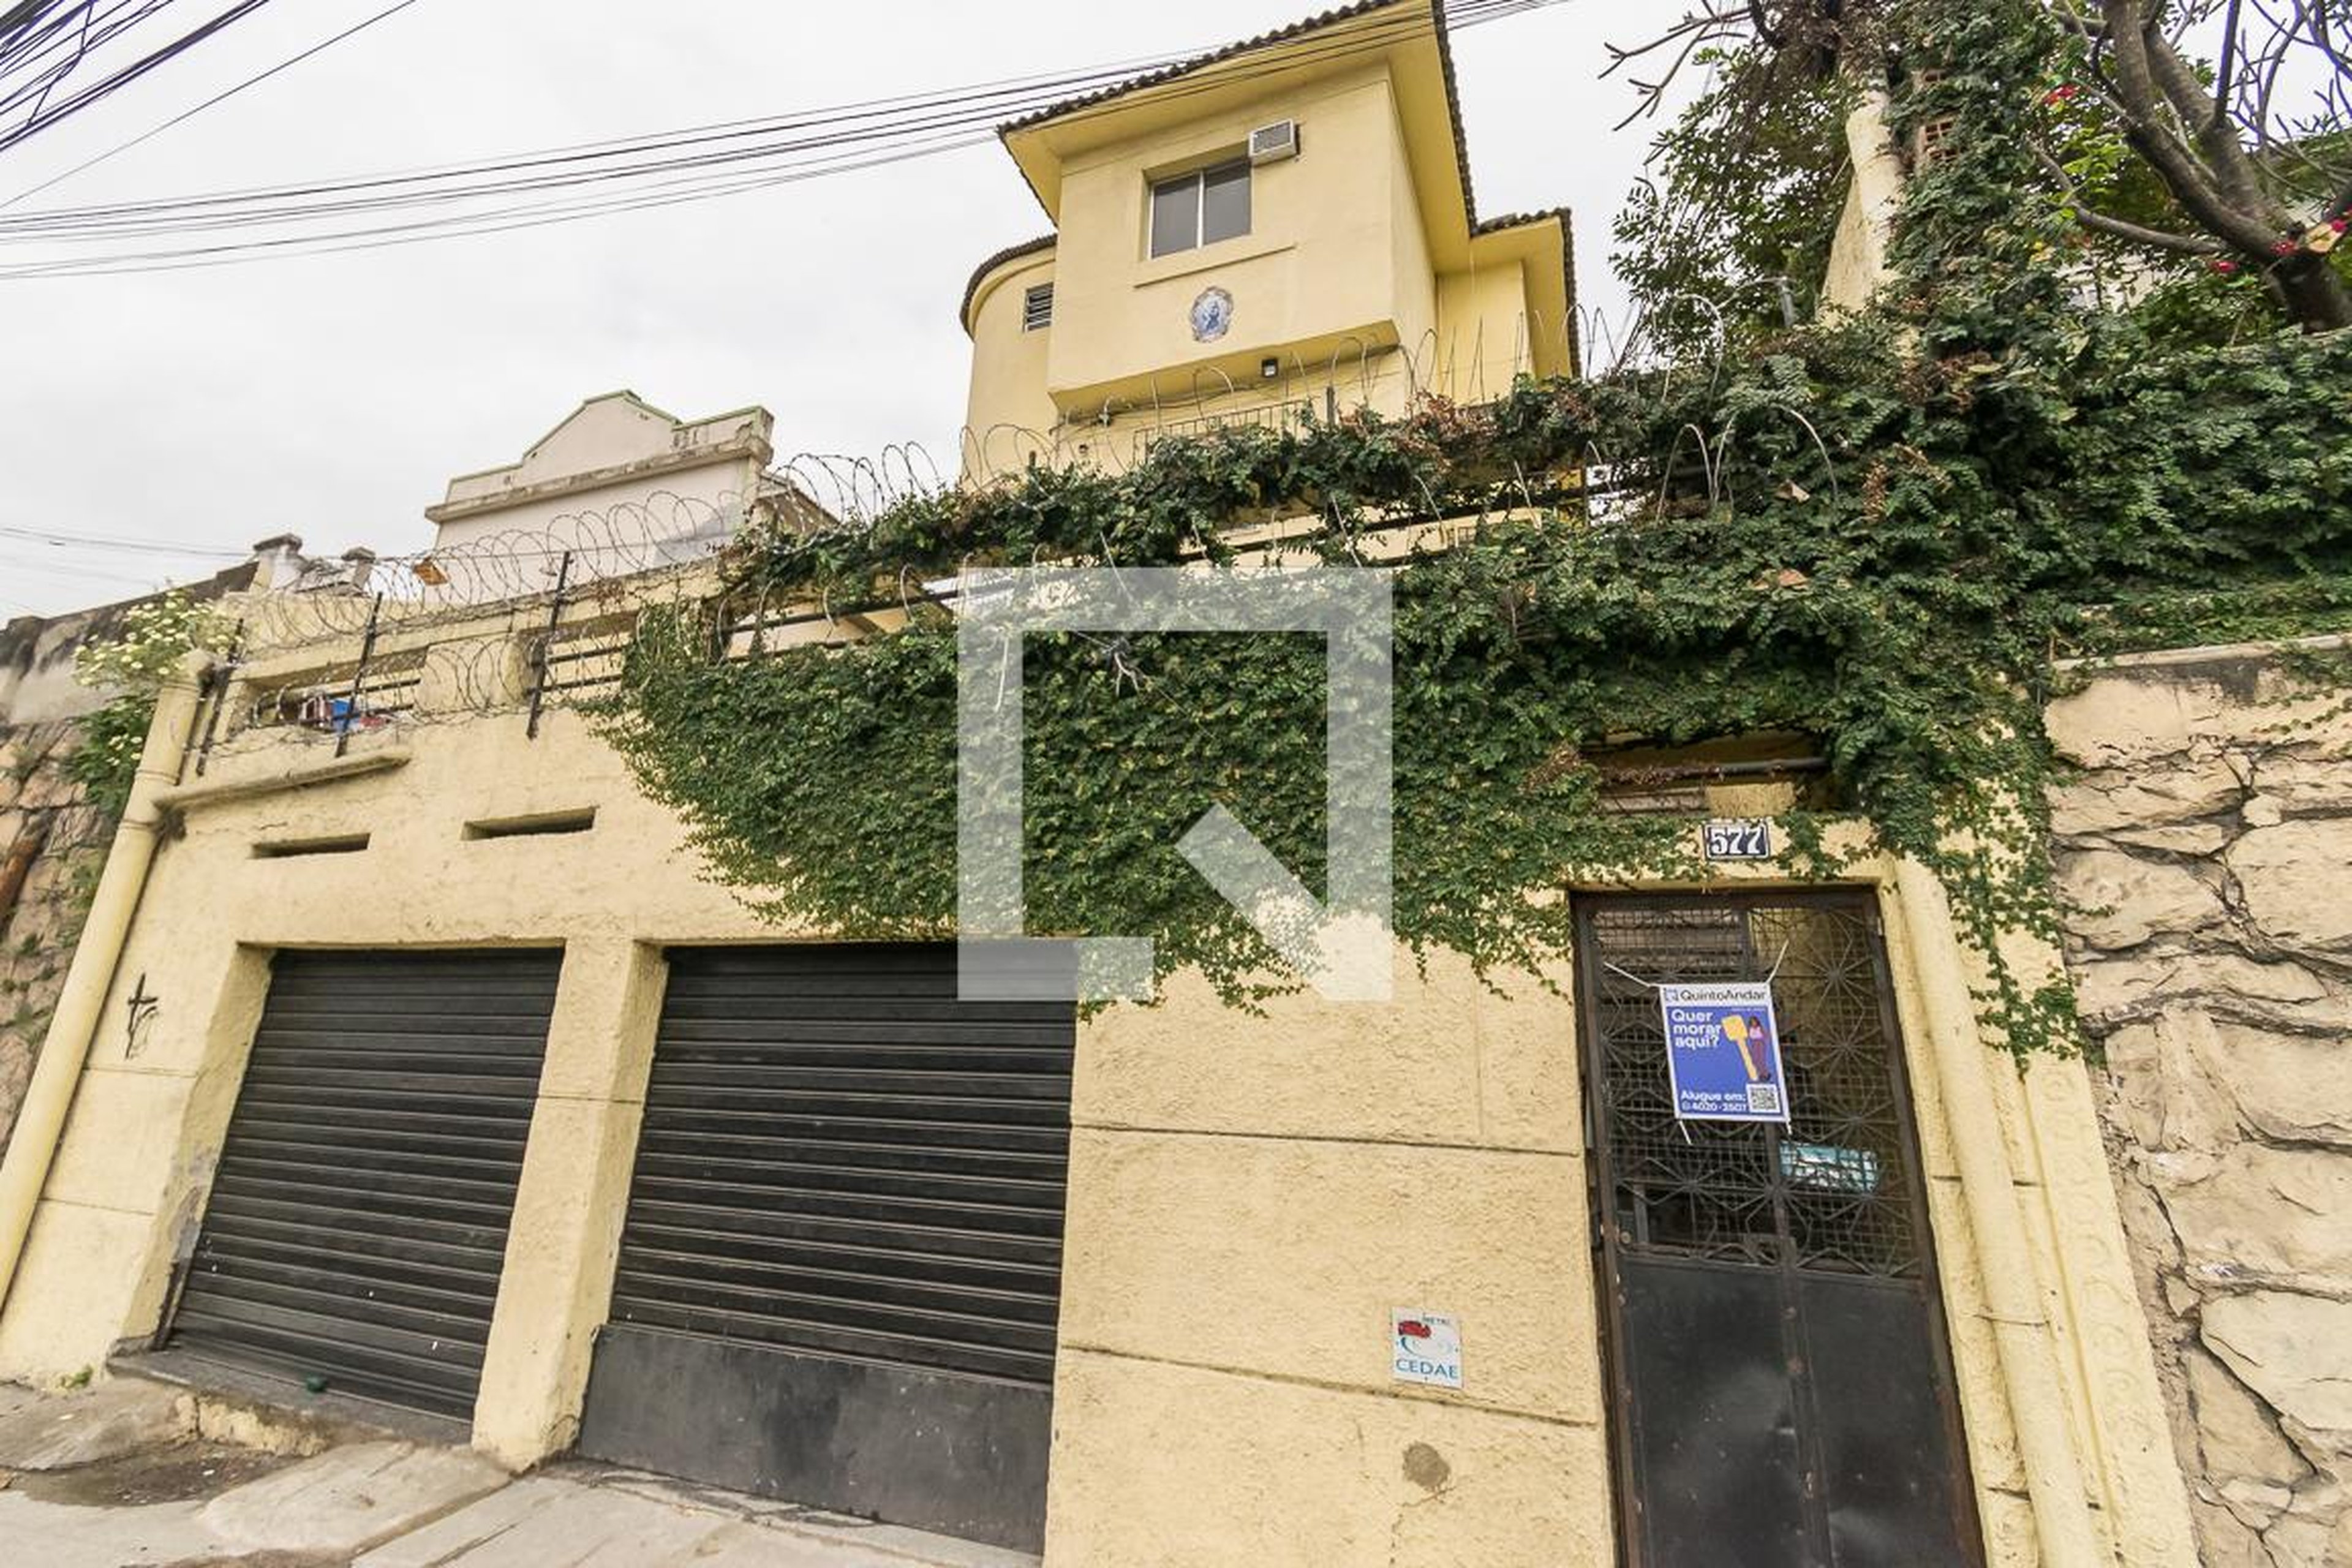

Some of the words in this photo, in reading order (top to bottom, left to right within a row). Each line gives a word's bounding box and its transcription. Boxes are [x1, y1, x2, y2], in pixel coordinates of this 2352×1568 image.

[1709, 826, 1762, 854] 577
[1680, 989, 1766, 1001] QuintoAndar
[1672, 1009, 1714, 1023] Quer
[1673, 1024, 1722, 1035] morar
[1675, 1035, 1719, 1050] aqui?
[1396, 1359, 1458, 1379] CEDAE
